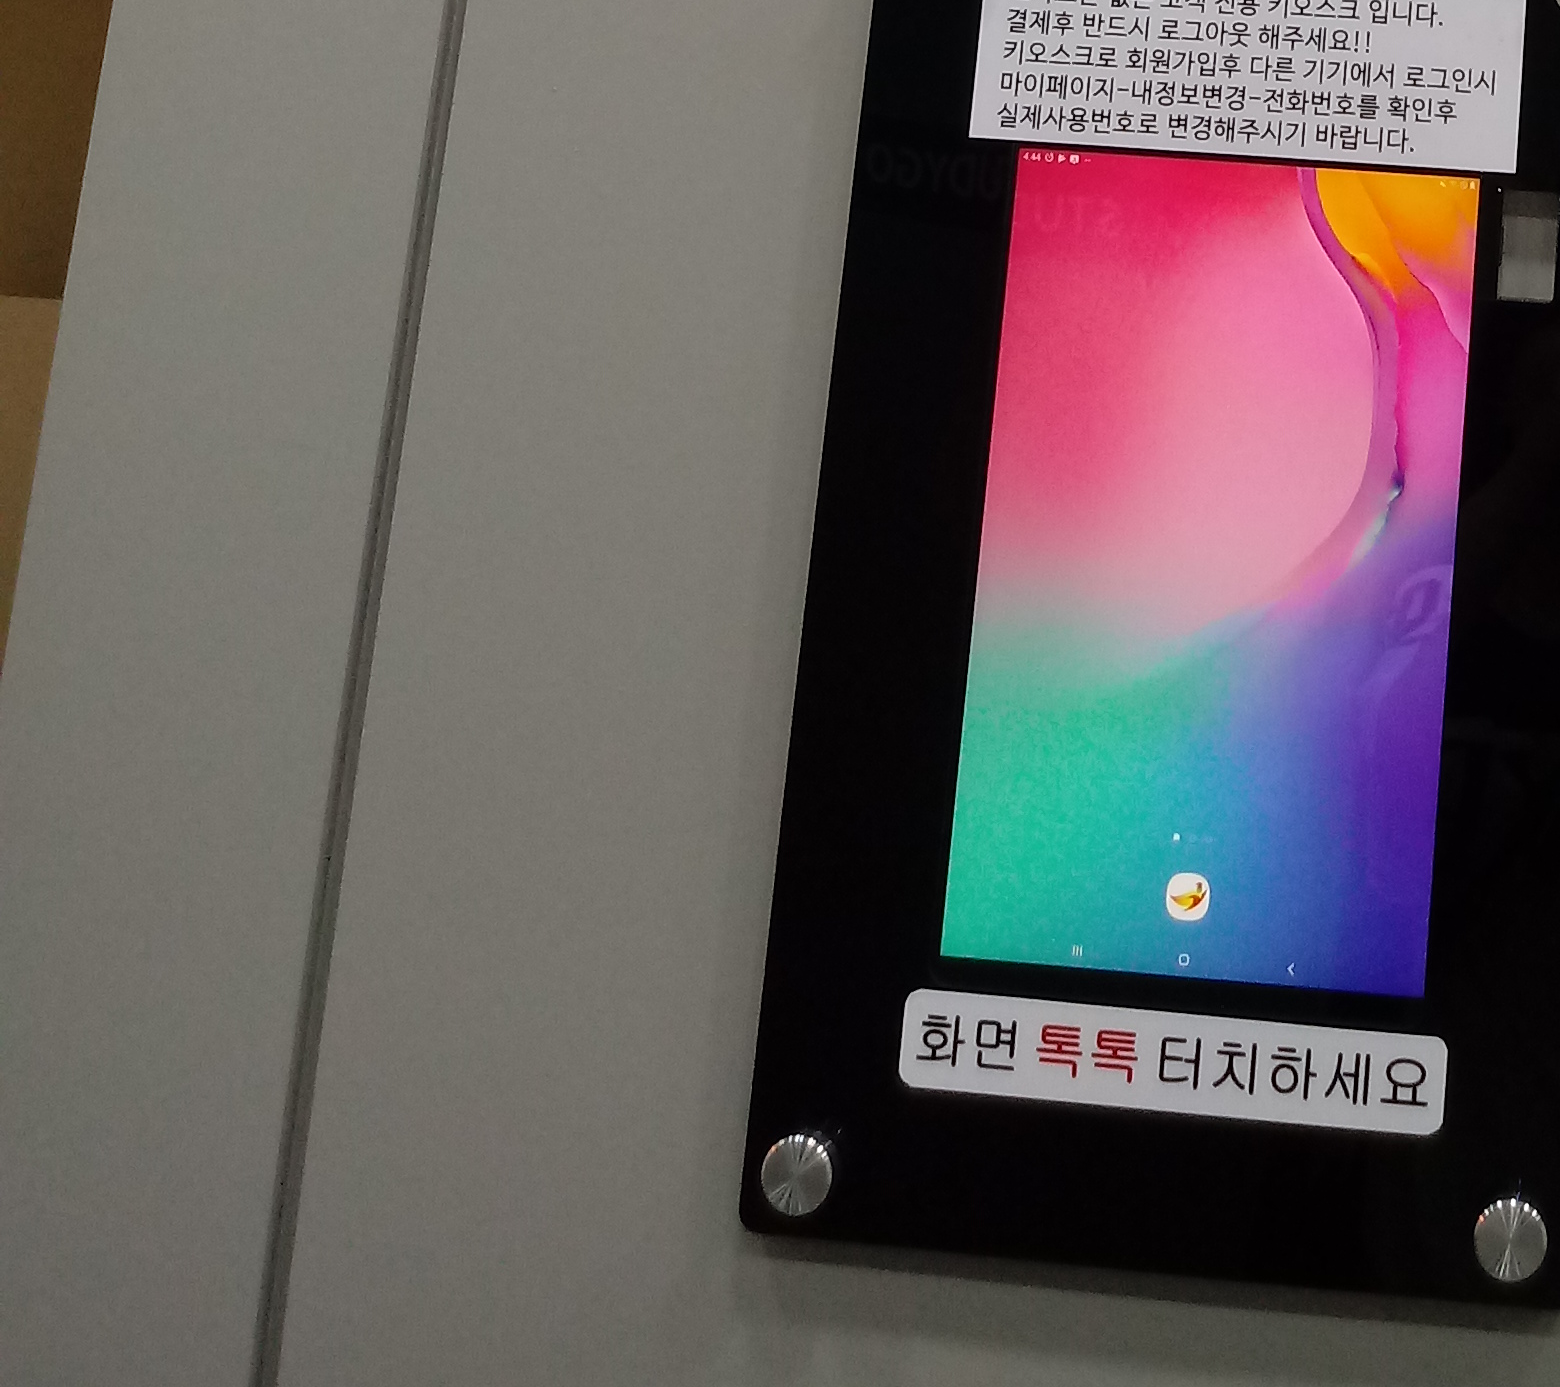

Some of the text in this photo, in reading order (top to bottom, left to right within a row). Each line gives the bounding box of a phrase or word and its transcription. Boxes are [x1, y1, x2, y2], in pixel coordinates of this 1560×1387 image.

[1006, 7, 1372, 54] 결제후 반드시 로그아웃 해주세요!!
[1002, 39, 1497, 96] 키오스크로 회원가입후 다른 기기에서 로그인시
[996, 102, 1415, 155] 실제사용번호로 변경해주시기 바랍니다.
[1386, 94, 1458, 125] 확인후
[915, 1013, 1430, 1109] 화면 톡톡 터치하세요
